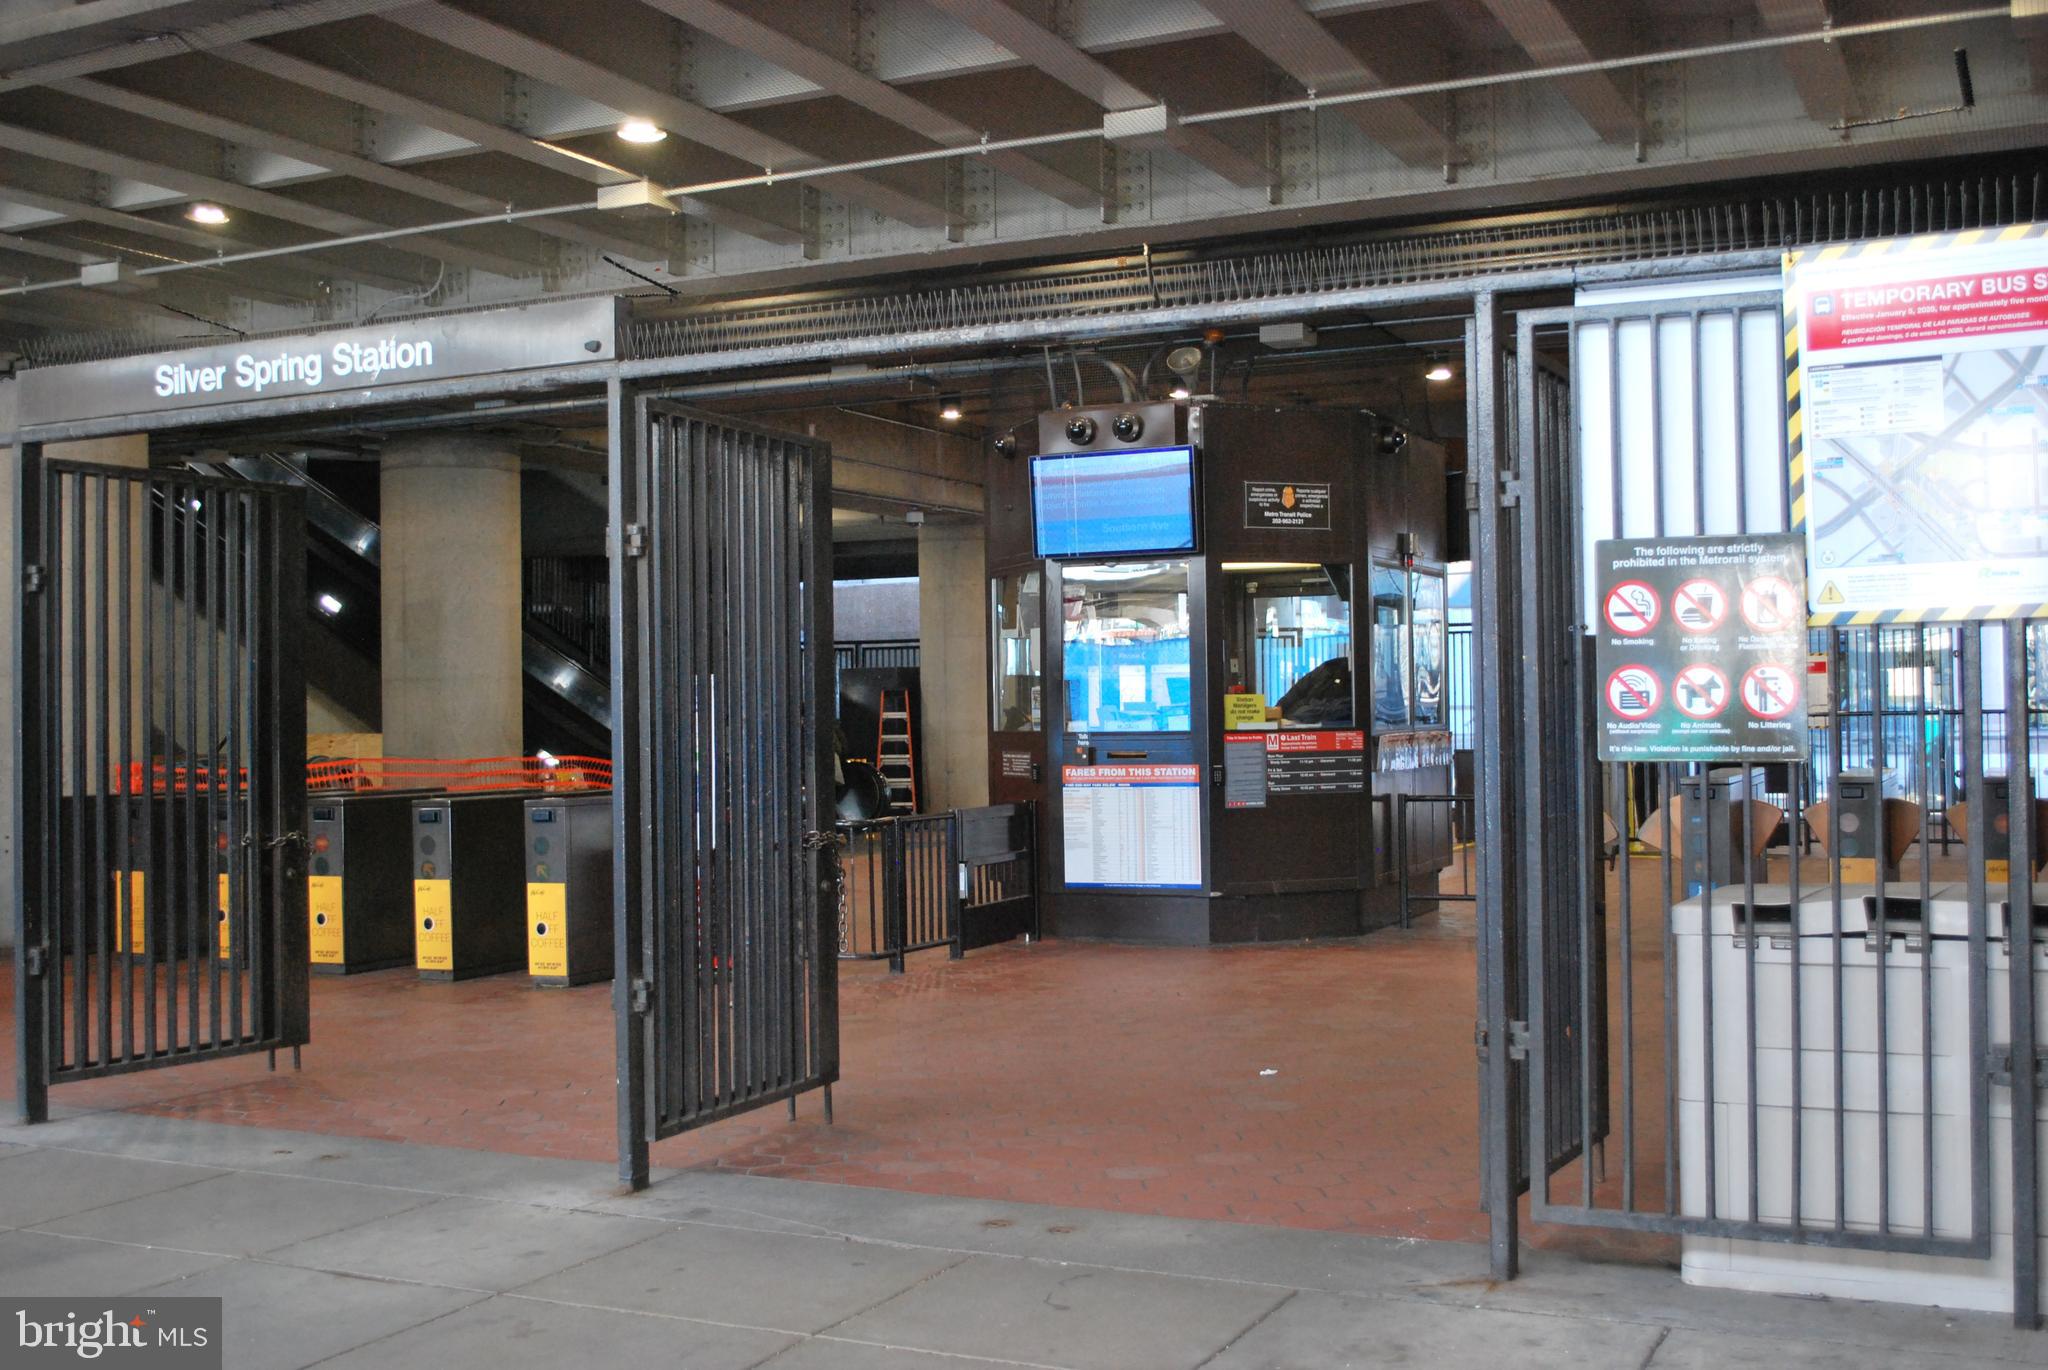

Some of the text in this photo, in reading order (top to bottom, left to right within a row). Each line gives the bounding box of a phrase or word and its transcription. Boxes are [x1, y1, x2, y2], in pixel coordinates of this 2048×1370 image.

[1840, 272, 2048, 309] TEMPORARY BUS S
[1841, 311, 1874, 322] Effective
[1875, 308, 1907, 319] January
[1917, 305, 1938, 315] 2020,
[1939, 304, 1951, 312] for
[1952, 299, 2008, 312] approximately
[2009, 297, 2025, 306] five
[1887, 321, 1921, 332] TEMPORAL
[1933, 319, 1945, 327] LAS
[1947, 316, 1977, 326] PARADAS
[1978, 315, 1988, 323] DE
[1989, 312, 2031, 322] AUTOBUSES
[1847, 335, 1864, 345] partir
[1876, 332, 1904, 343] domingo,
[1910, 330, 1918, 338] de
[1919, 329, 1938, 337] enero
[155, 339, 433, 397] Silver Spring Station
[1634, 543, 1765, 558] The following are strictly
[1612, 555, 1665, 570] prohibited
[1667, 556, 1678, 566] in
[1680, 555, 1697, 566] the
[1699, 554, 1746, 565] Metrorail
[1611, 637, 1654, 647] No Smoking
[1682, 636, 1692, 644] No
[1680, 642, 1720, 652] or Drinking
[1618, 721, 1661, 730] Audio/Video
[1692, 721, 1722, 729] Animals
[1748, 721, 1791, 730] No Littering
[1301, 733, 1317, 741] Train
[1690, 745, 1729, 754] punishable
[1731, 745, 1740, 754] by
[1782, 745, 1796, 754] jail.
[1066, 767, 1196, 777] FARES FROM THIS STATION
